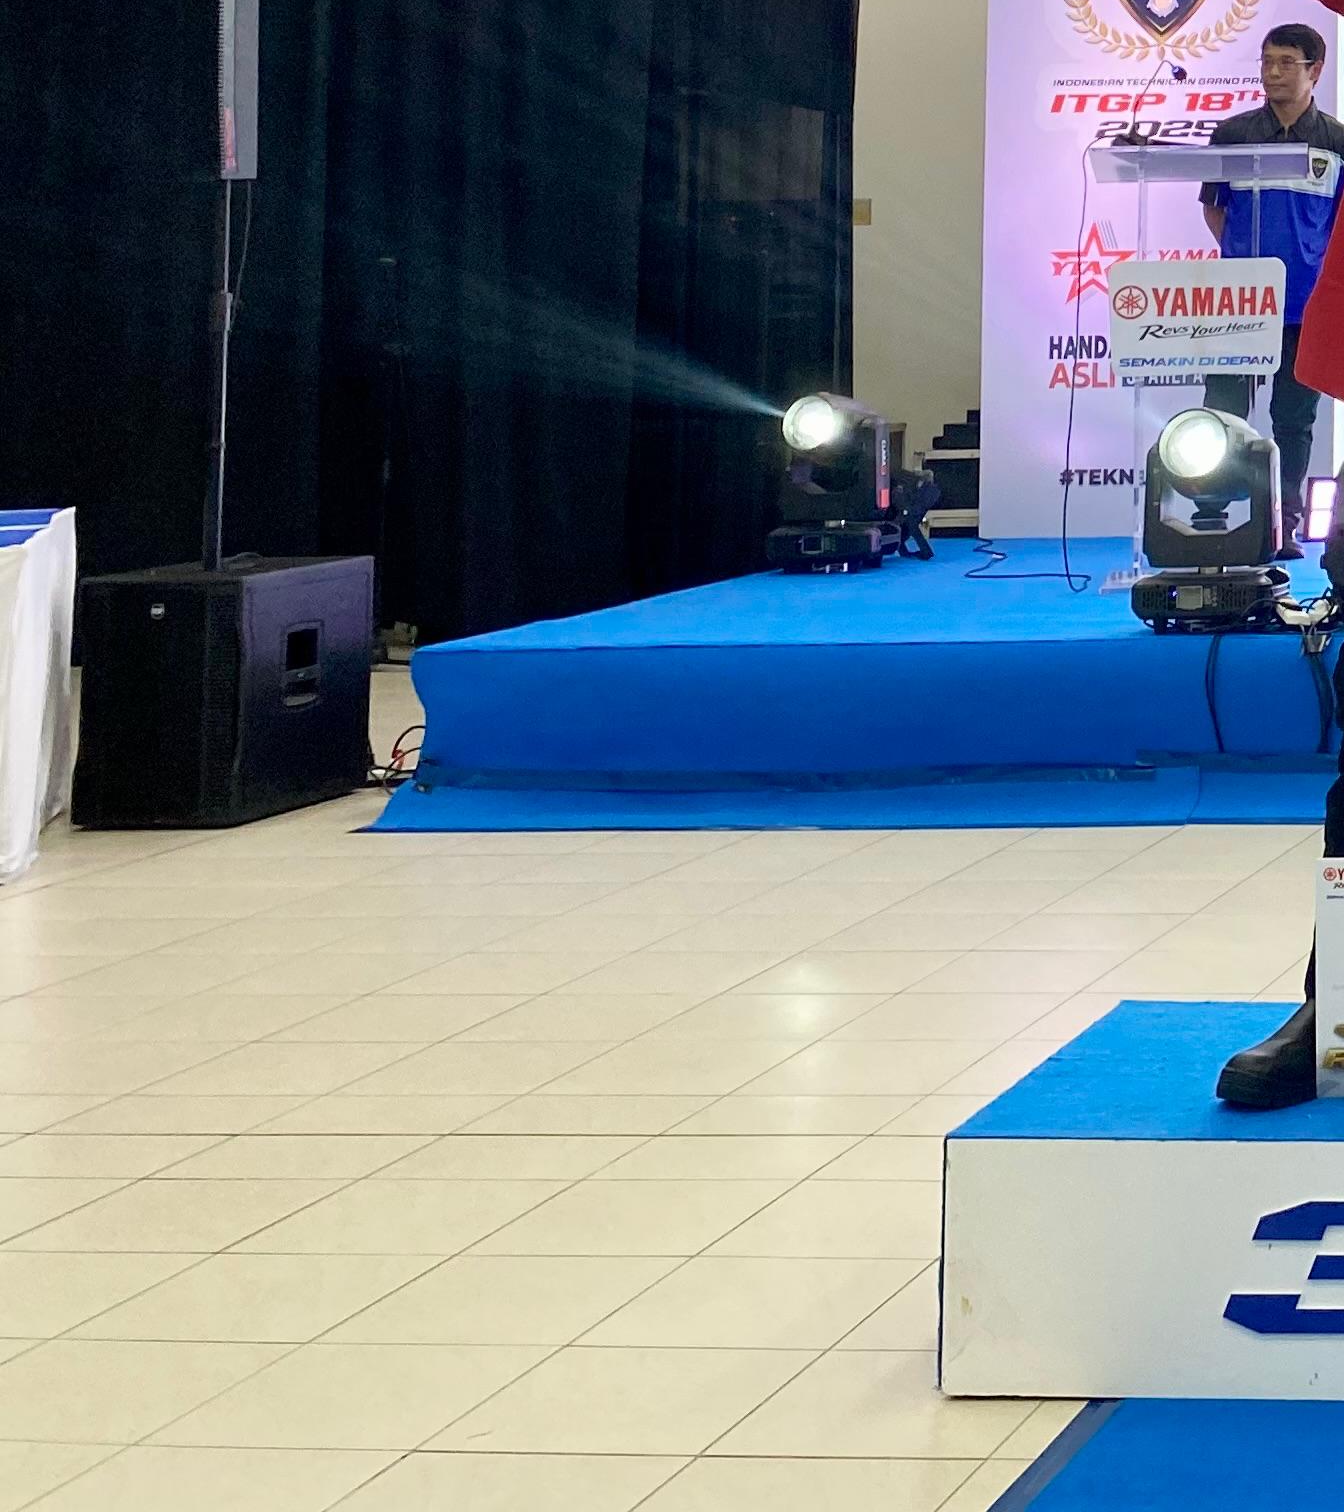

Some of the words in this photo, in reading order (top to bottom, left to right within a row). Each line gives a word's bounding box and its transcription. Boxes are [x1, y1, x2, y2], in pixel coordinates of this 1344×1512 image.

[1052, 78, 1124, 87] INDONESIAN
[1198, 77, 1240, 86] GRAND
[1050, 93, 1167, 113] ITGP
[1158, 248, 1219, 261] YAMA
[1152, 286, 1277, 317] YAMAHA
[1139, 324, 1189, 341] Revs
[1189, 324, 1227, 339] Your
[1227, 321, 1265, 331] Heart
[1049, 336, 1111, 360] HAND
[1119, 356, 1195, 368] SEMAKIN
[1199, 356, 1216, 366] DI
[1217, 355, 1274, 366] DEPAN
[1049, 362, 1116, 389] ASLI
